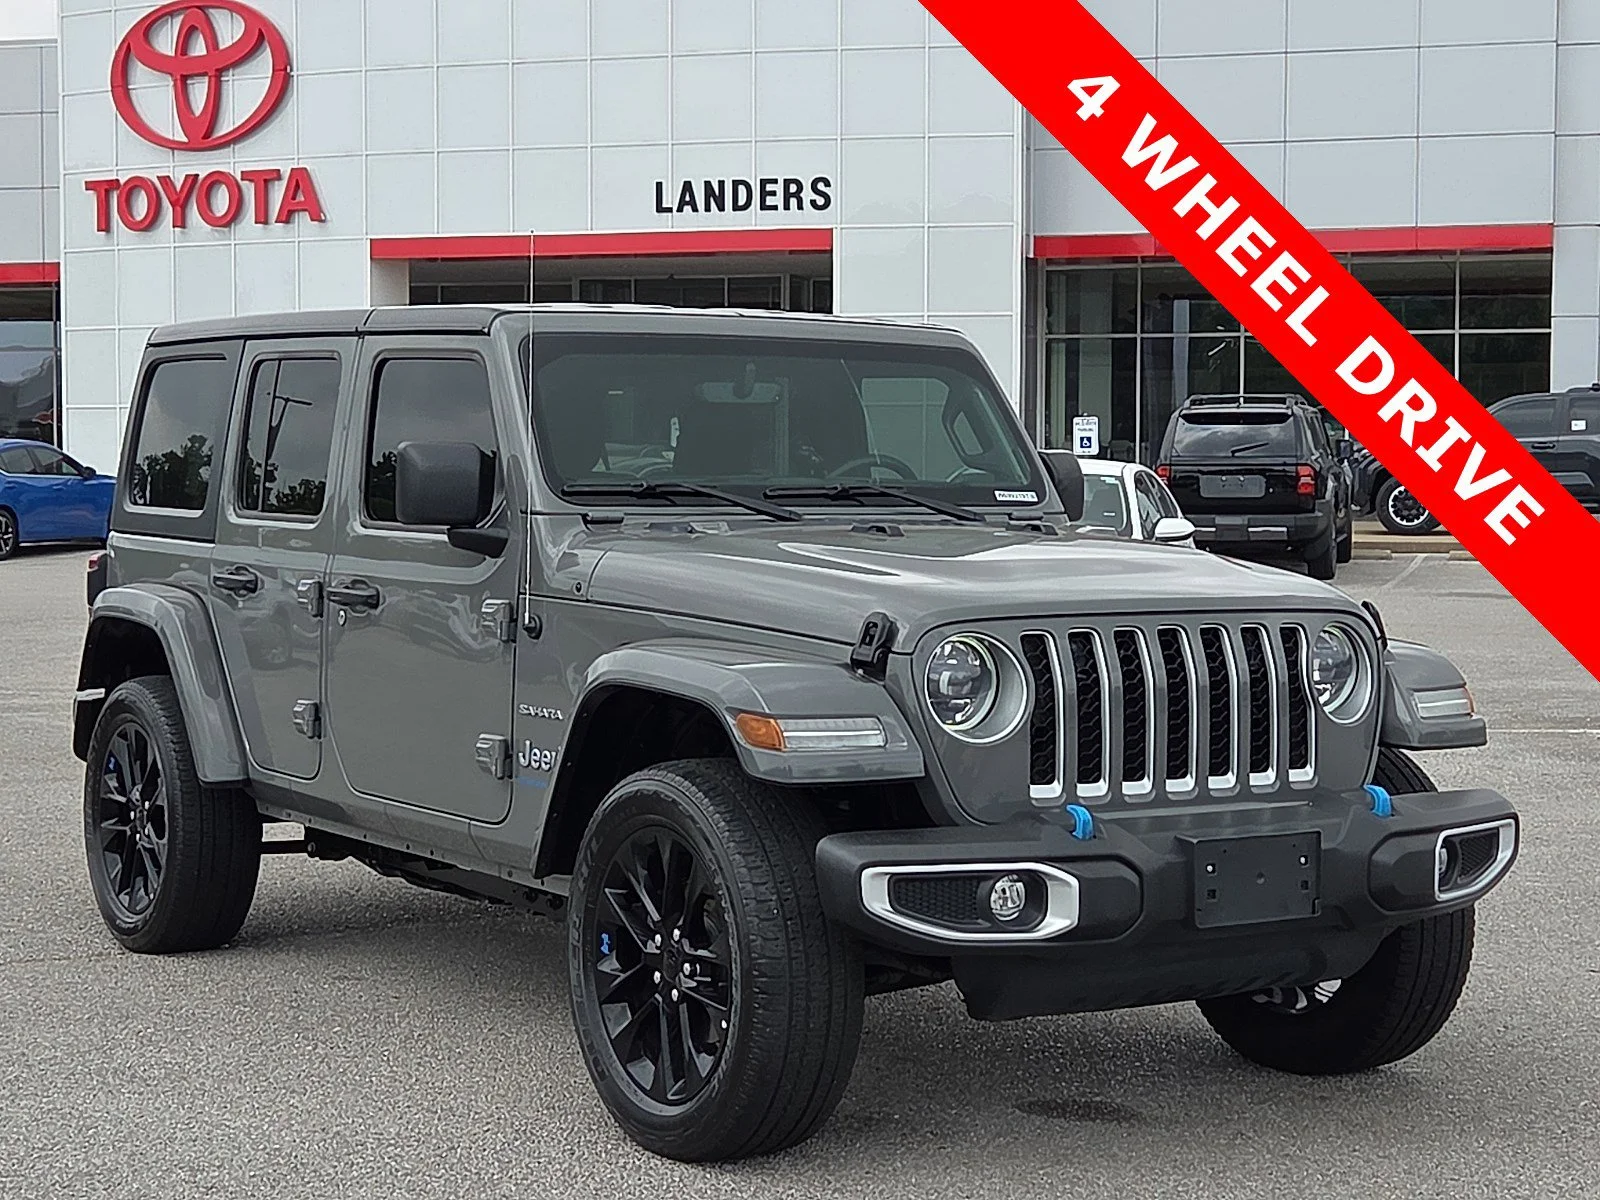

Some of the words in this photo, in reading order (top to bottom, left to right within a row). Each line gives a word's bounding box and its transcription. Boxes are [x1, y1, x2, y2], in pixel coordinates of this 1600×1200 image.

[84, 167, 325, 233] TOYOTA
[655, 176, 832, 213] LANDERS
[518, 704, 563, 720] SAHARA
